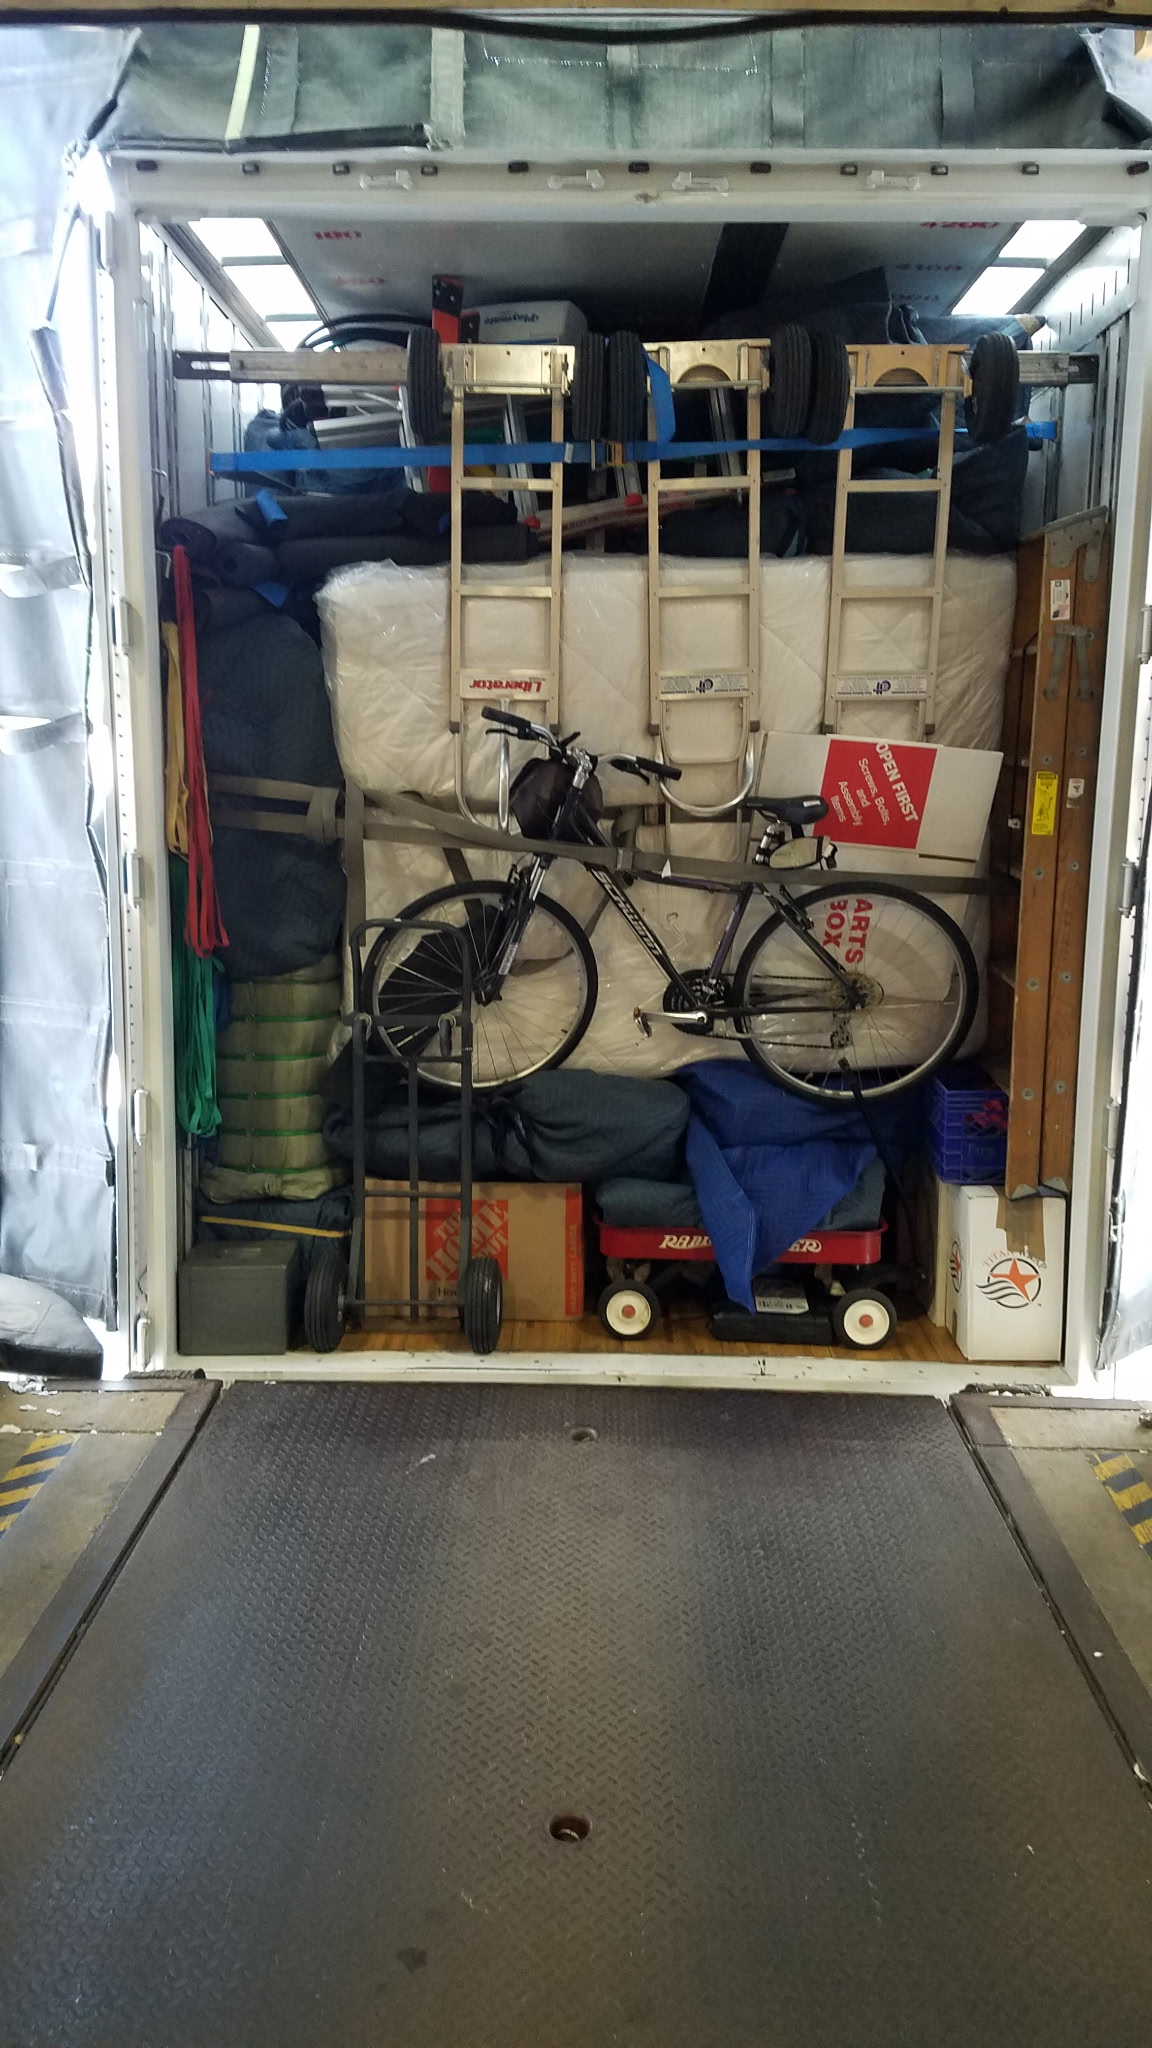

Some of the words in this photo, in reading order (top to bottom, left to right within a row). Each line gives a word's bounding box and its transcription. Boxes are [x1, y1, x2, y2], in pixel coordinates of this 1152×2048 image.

[469, 680, 542, 692] Liberator
[858, 757, 878, 798] Screws,
[875, 797, 890, 826] Bolts,
[875, 742, 901, 782] OPEN
[892, 781, 919, 821] FIRST
[830, 795, 846, 822] Items
[838, 781, 862, 826] Assembly
[856, 788, 871, 808] and
[659, 1235, 712, 1249] RADI
